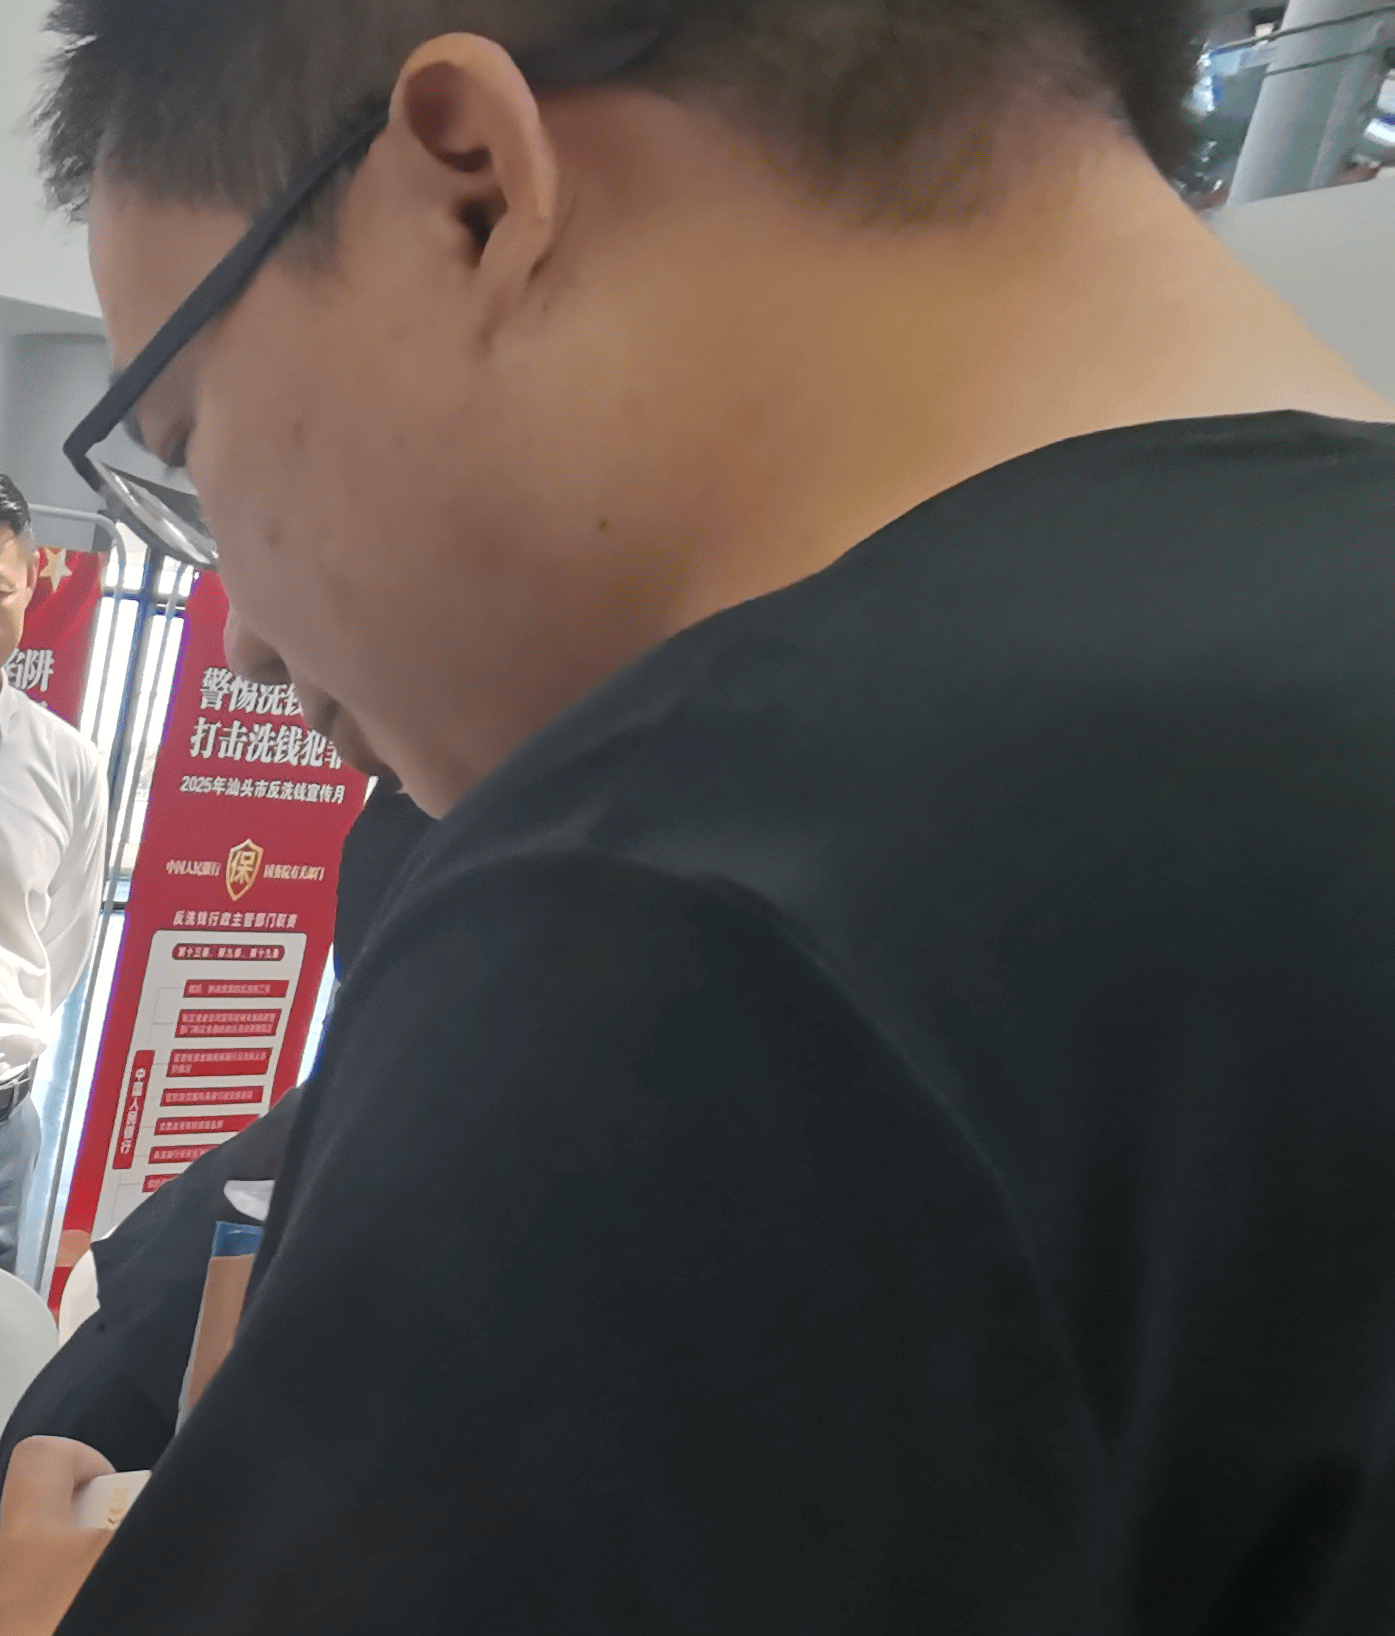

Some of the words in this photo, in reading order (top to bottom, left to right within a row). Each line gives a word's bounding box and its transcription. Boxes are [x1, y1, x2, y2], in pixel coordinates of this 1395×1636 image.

[179, 775, 346, 805] 2025年汕头市反洗钱宣传月
